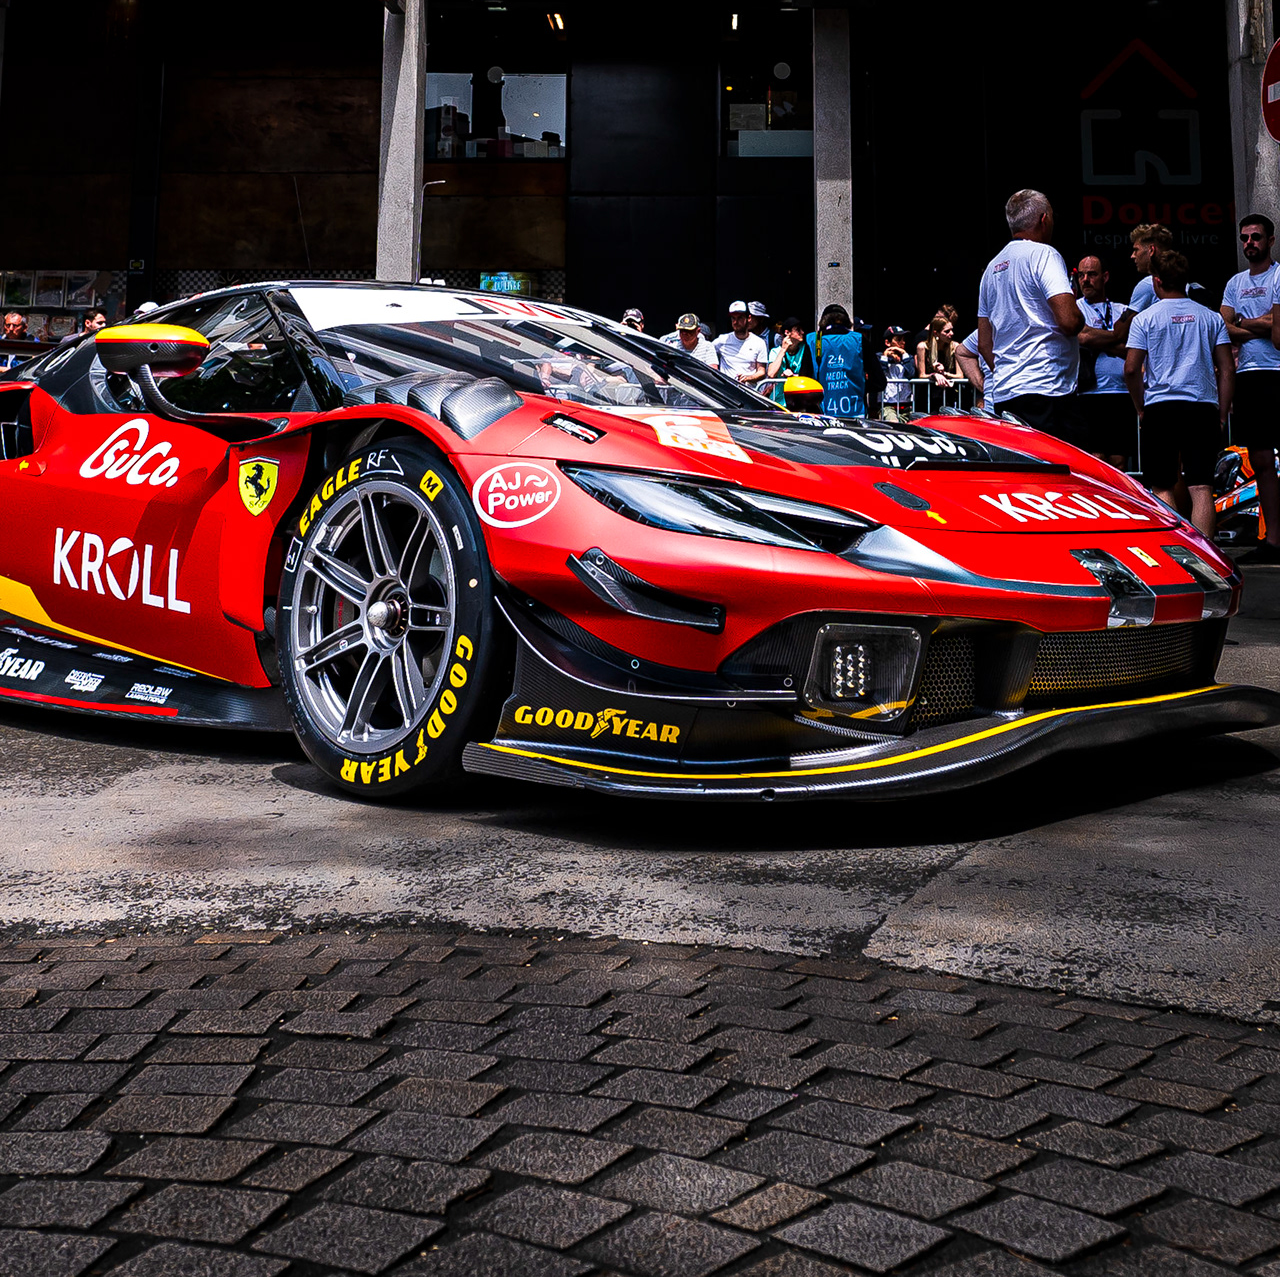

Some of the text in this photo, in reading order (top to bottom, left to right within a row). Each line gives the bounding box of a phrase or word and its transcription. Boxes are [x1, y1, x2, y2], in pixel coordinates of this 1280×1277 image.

[825, 371, 848, 381] MEDIA
[827, 380, 849, 391] TRACK
[826, 394, 859, 414] 407
[366, 449, 389, 470] RF
[423, 476, 439, 494] M
[487, 471, 521, 493] AJ
[299, 457, 362, 538] EAGLE
[487, 490, 553, 515] Power
[978, 491, 1151, 523] KROLL
[53, 527, 191, 614] KROLL
[339, 634, 474, 784] GOODYEAR
[514, 705, 681, 744] GOODYEAR
